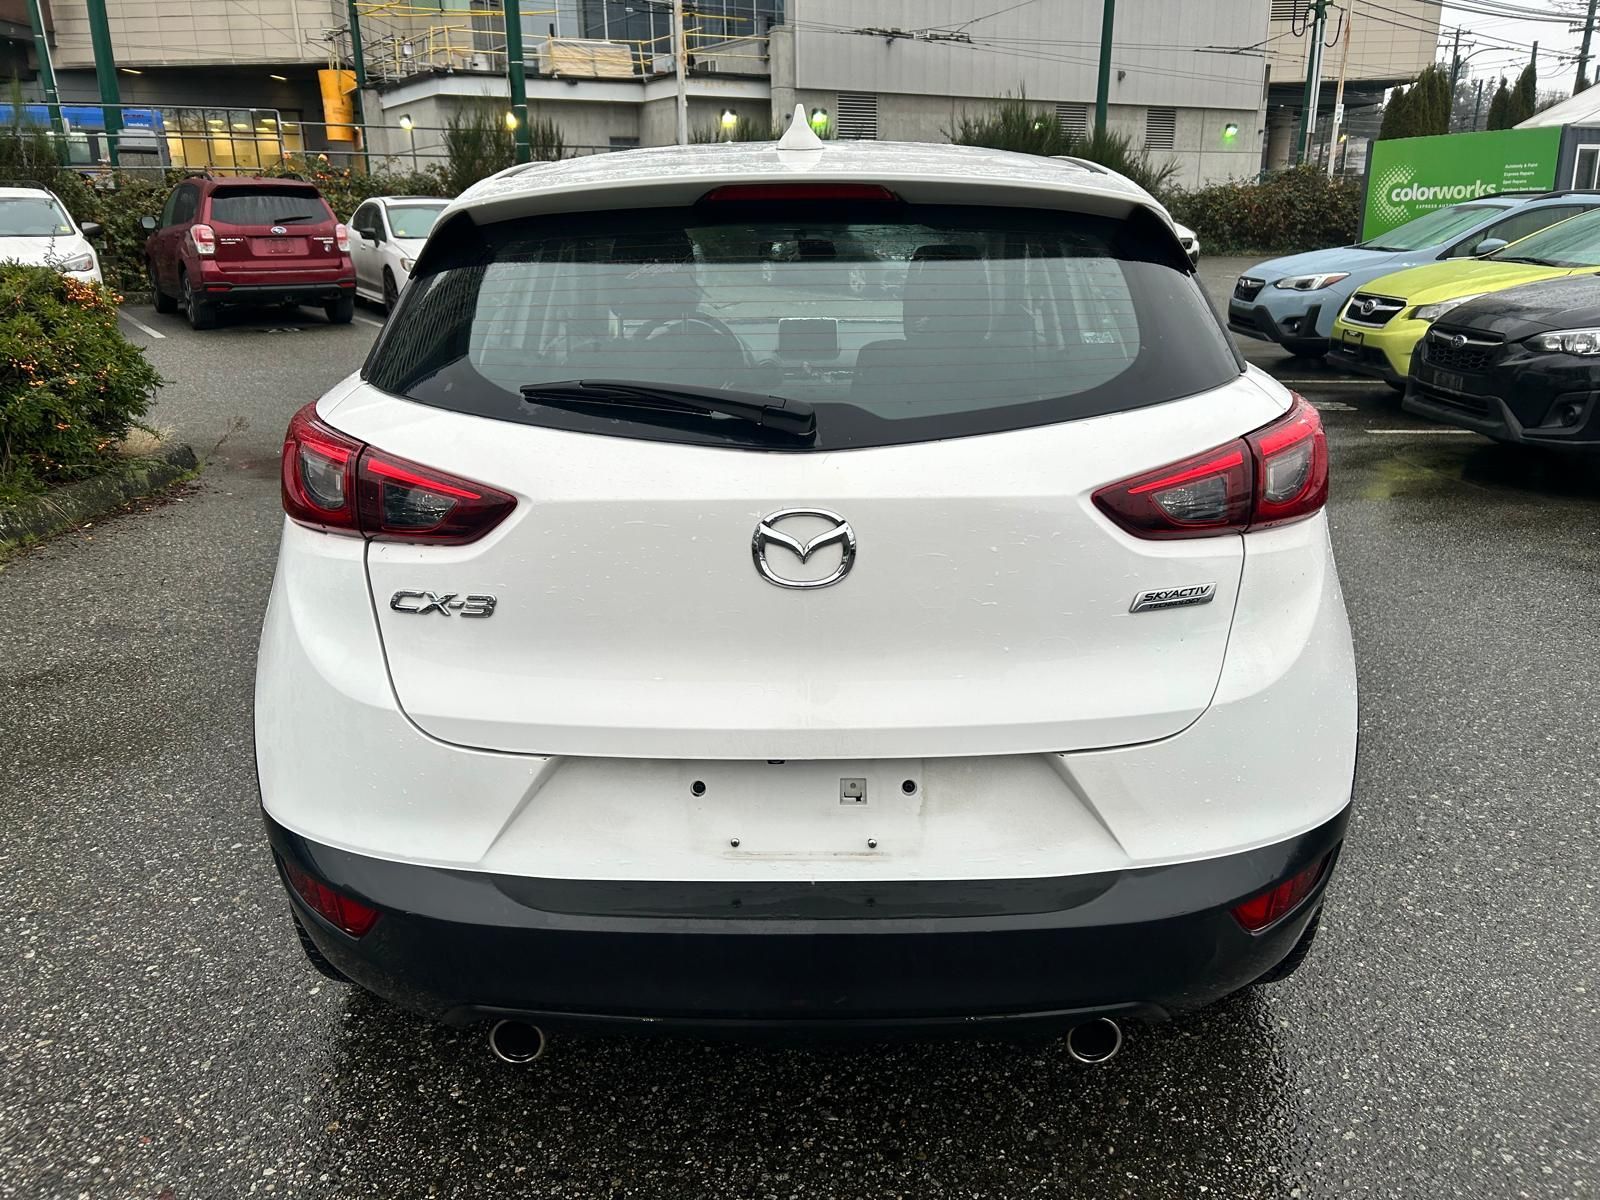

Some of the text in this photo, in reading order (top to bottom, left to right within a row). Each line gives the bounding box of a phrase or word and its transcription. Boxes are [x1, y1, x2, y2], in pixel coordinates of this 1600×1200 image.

[1391, 179, 1497, 202] colorworks
[1143, 585, 1210, 602] SKYACTIV
[1148, 598, 1202, 609] TECHNOLOGY
[390, 590, 498, 618] CX-3
